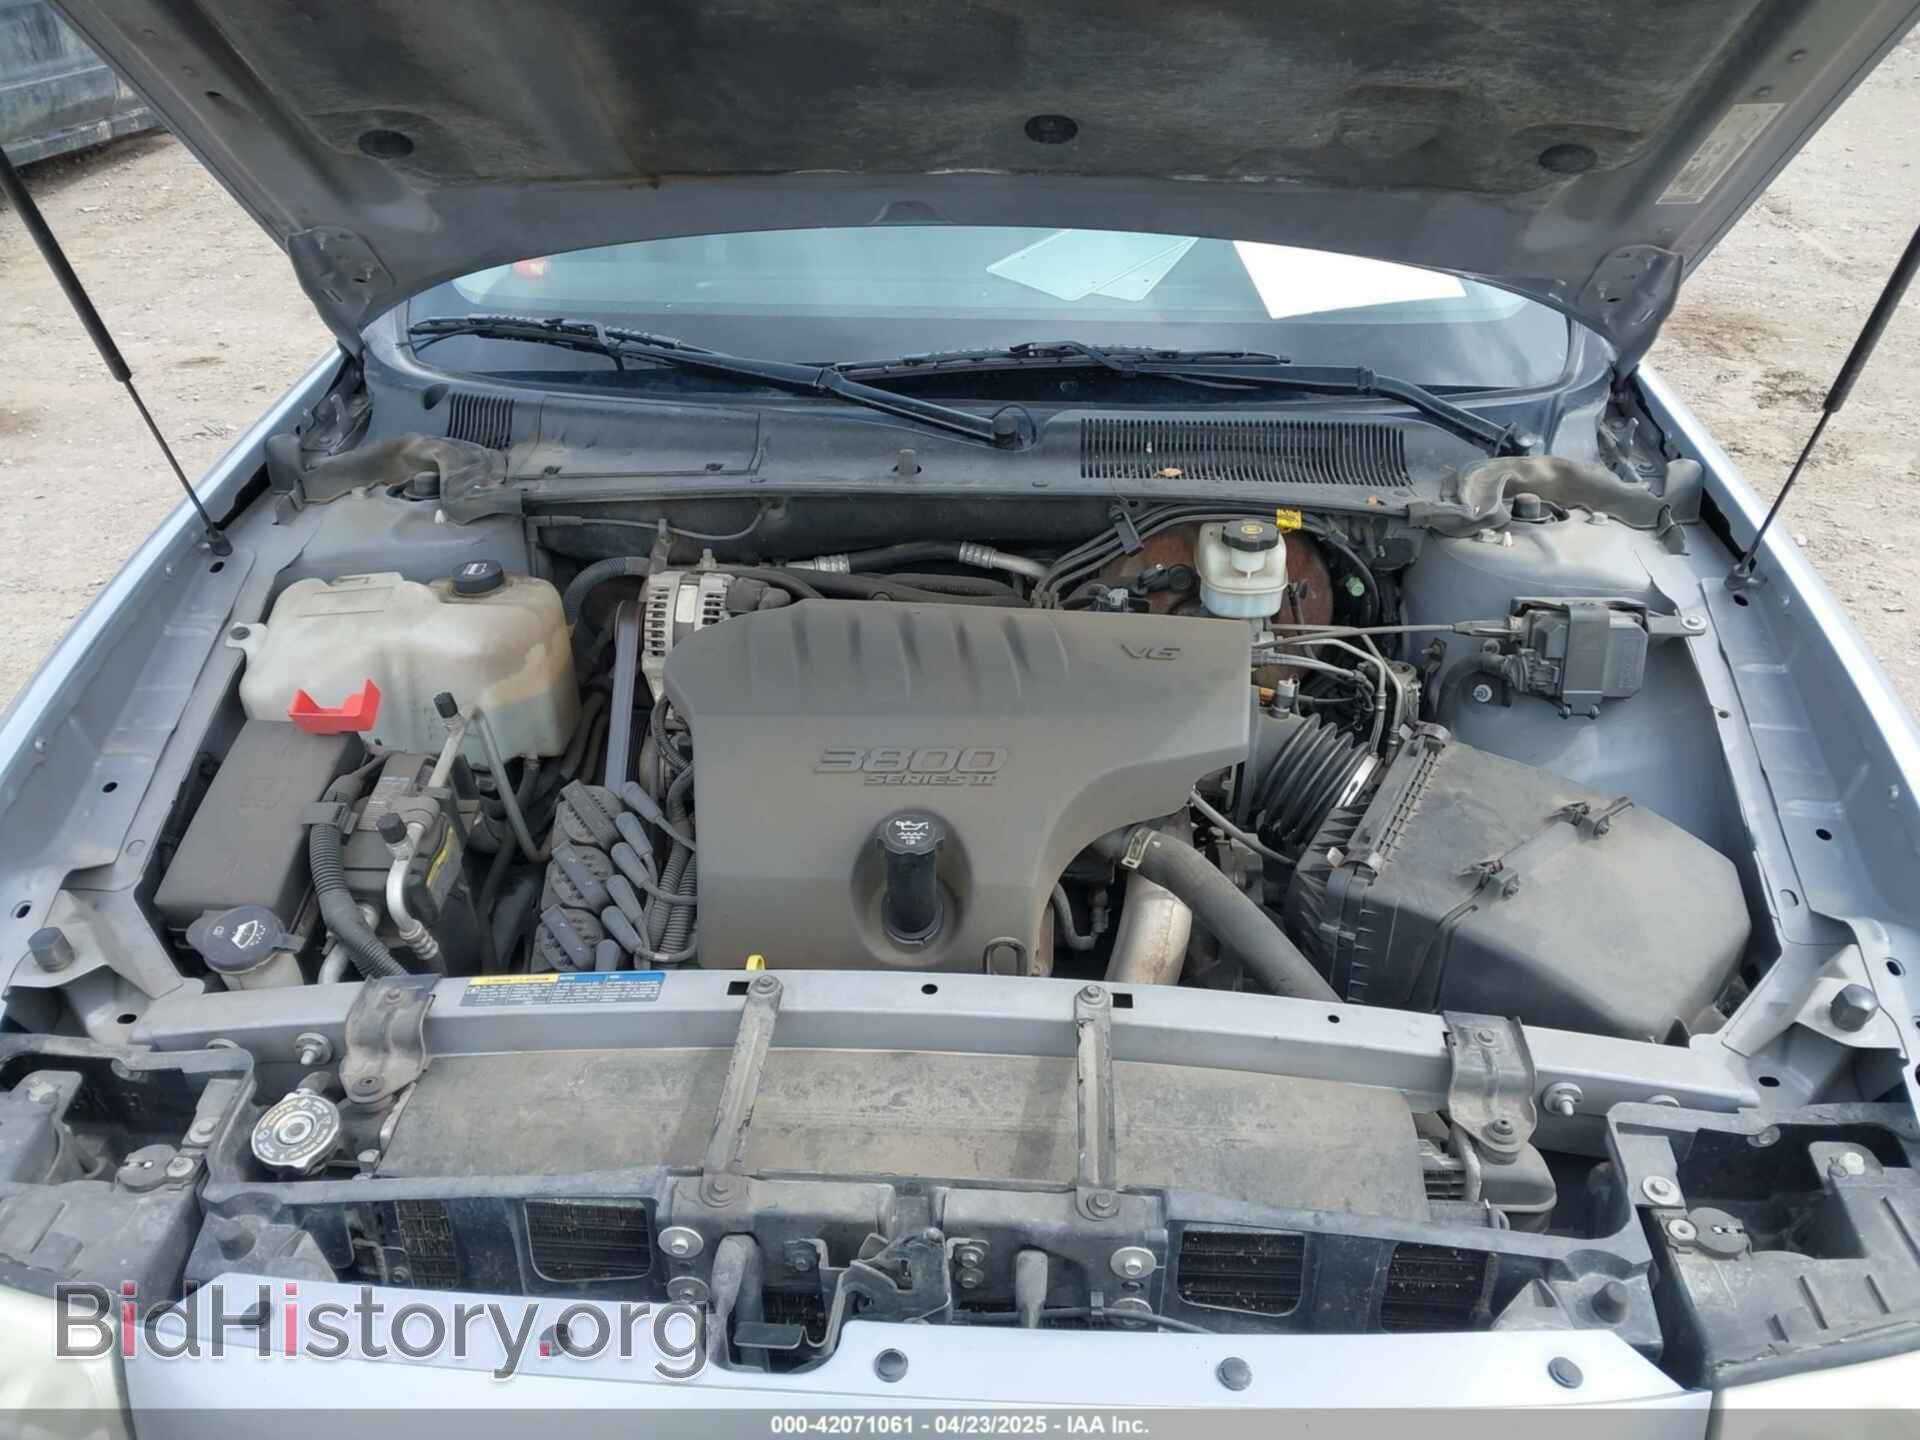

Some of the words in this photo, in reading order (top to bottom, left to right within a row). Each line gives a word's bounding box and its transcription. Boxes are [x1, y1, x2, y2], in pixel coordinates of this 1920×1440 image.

[1119, 641, 1181, 661] V6
[814, 746, 1007, 773] 3800
[863, 774, 968, 786] SERIES
